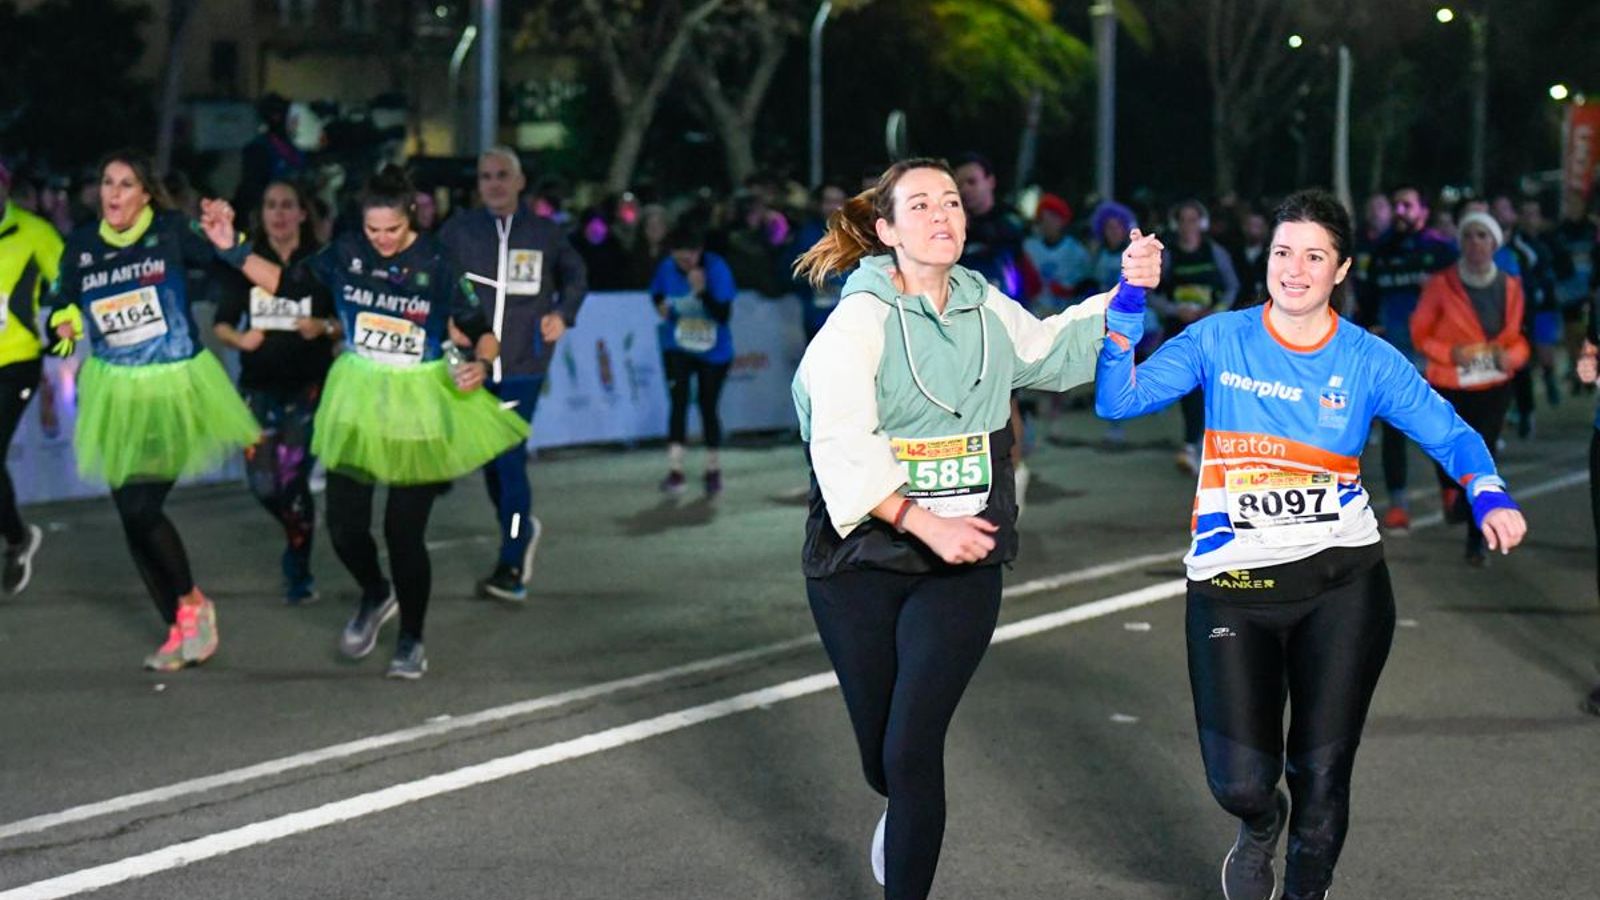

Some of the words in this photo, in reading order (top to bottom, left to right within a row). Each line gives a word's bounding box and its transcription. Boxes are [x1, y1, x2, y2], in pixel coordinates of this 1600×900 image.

[82, 271, 108, 292] SAN
[111, 257, 165, 284] ANTÓN
[343, 284, 373, 307] SAN
[376, 295, 430, 315] ANTÓN
[102, 304, 154, 330] 5164
[362, 328, 416, 350] 7795
[1220, 370, 1303, 402] enerplus
[907, 443, 927, 456] 42
[1238, 488, 1327, 520] 8097
[1211, 578, 1275, 589] HANKER
